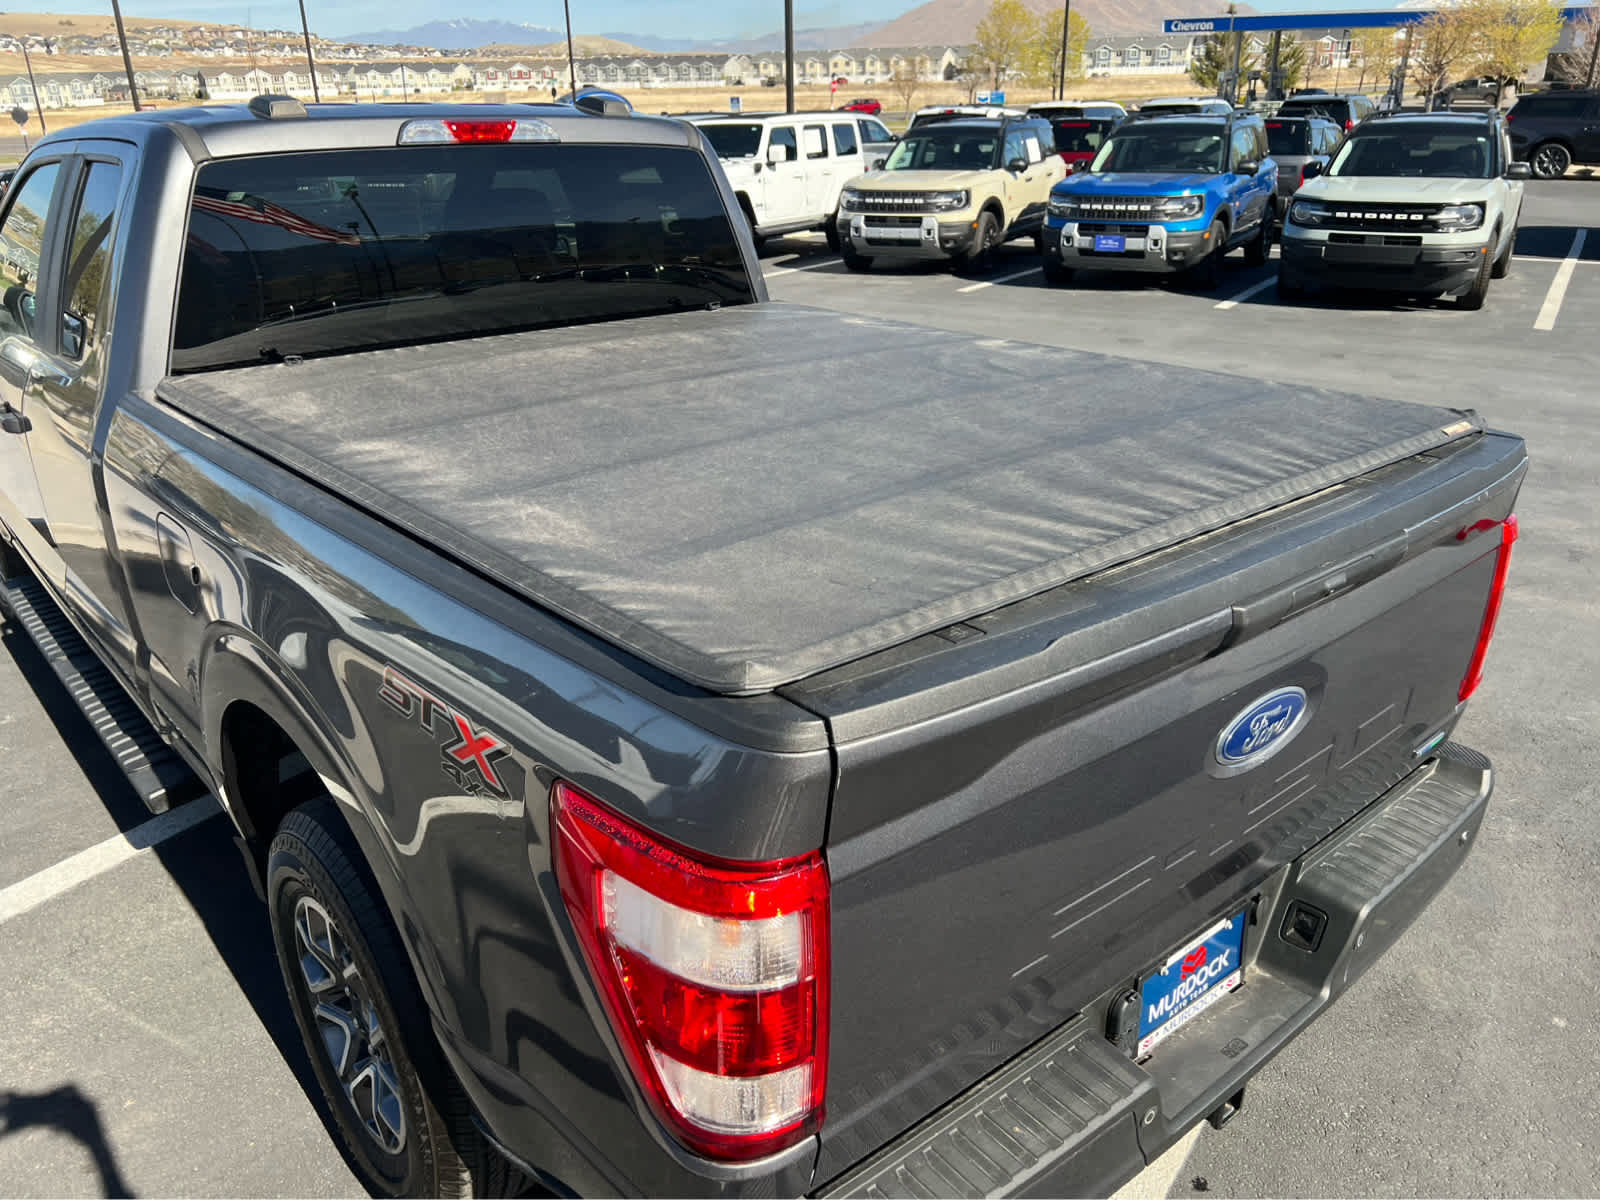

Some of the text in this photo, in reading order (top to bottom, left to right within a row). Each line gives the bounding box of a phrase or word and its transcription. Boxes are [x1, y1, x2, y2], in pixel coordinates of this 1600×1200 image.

[1170, 20, 1214, 31] Chevron
[1079, 203, 1150, 211] BRONCO
[1335, 211, 1424, 221] BRONCO
[378, 664, 513, 802] STX
[1241, 704, 1293, 753] Ford
[1148, 948, 1231, 1023] MURDOCK
[1168, 982, 1209, 1018] AUTO TEAM
